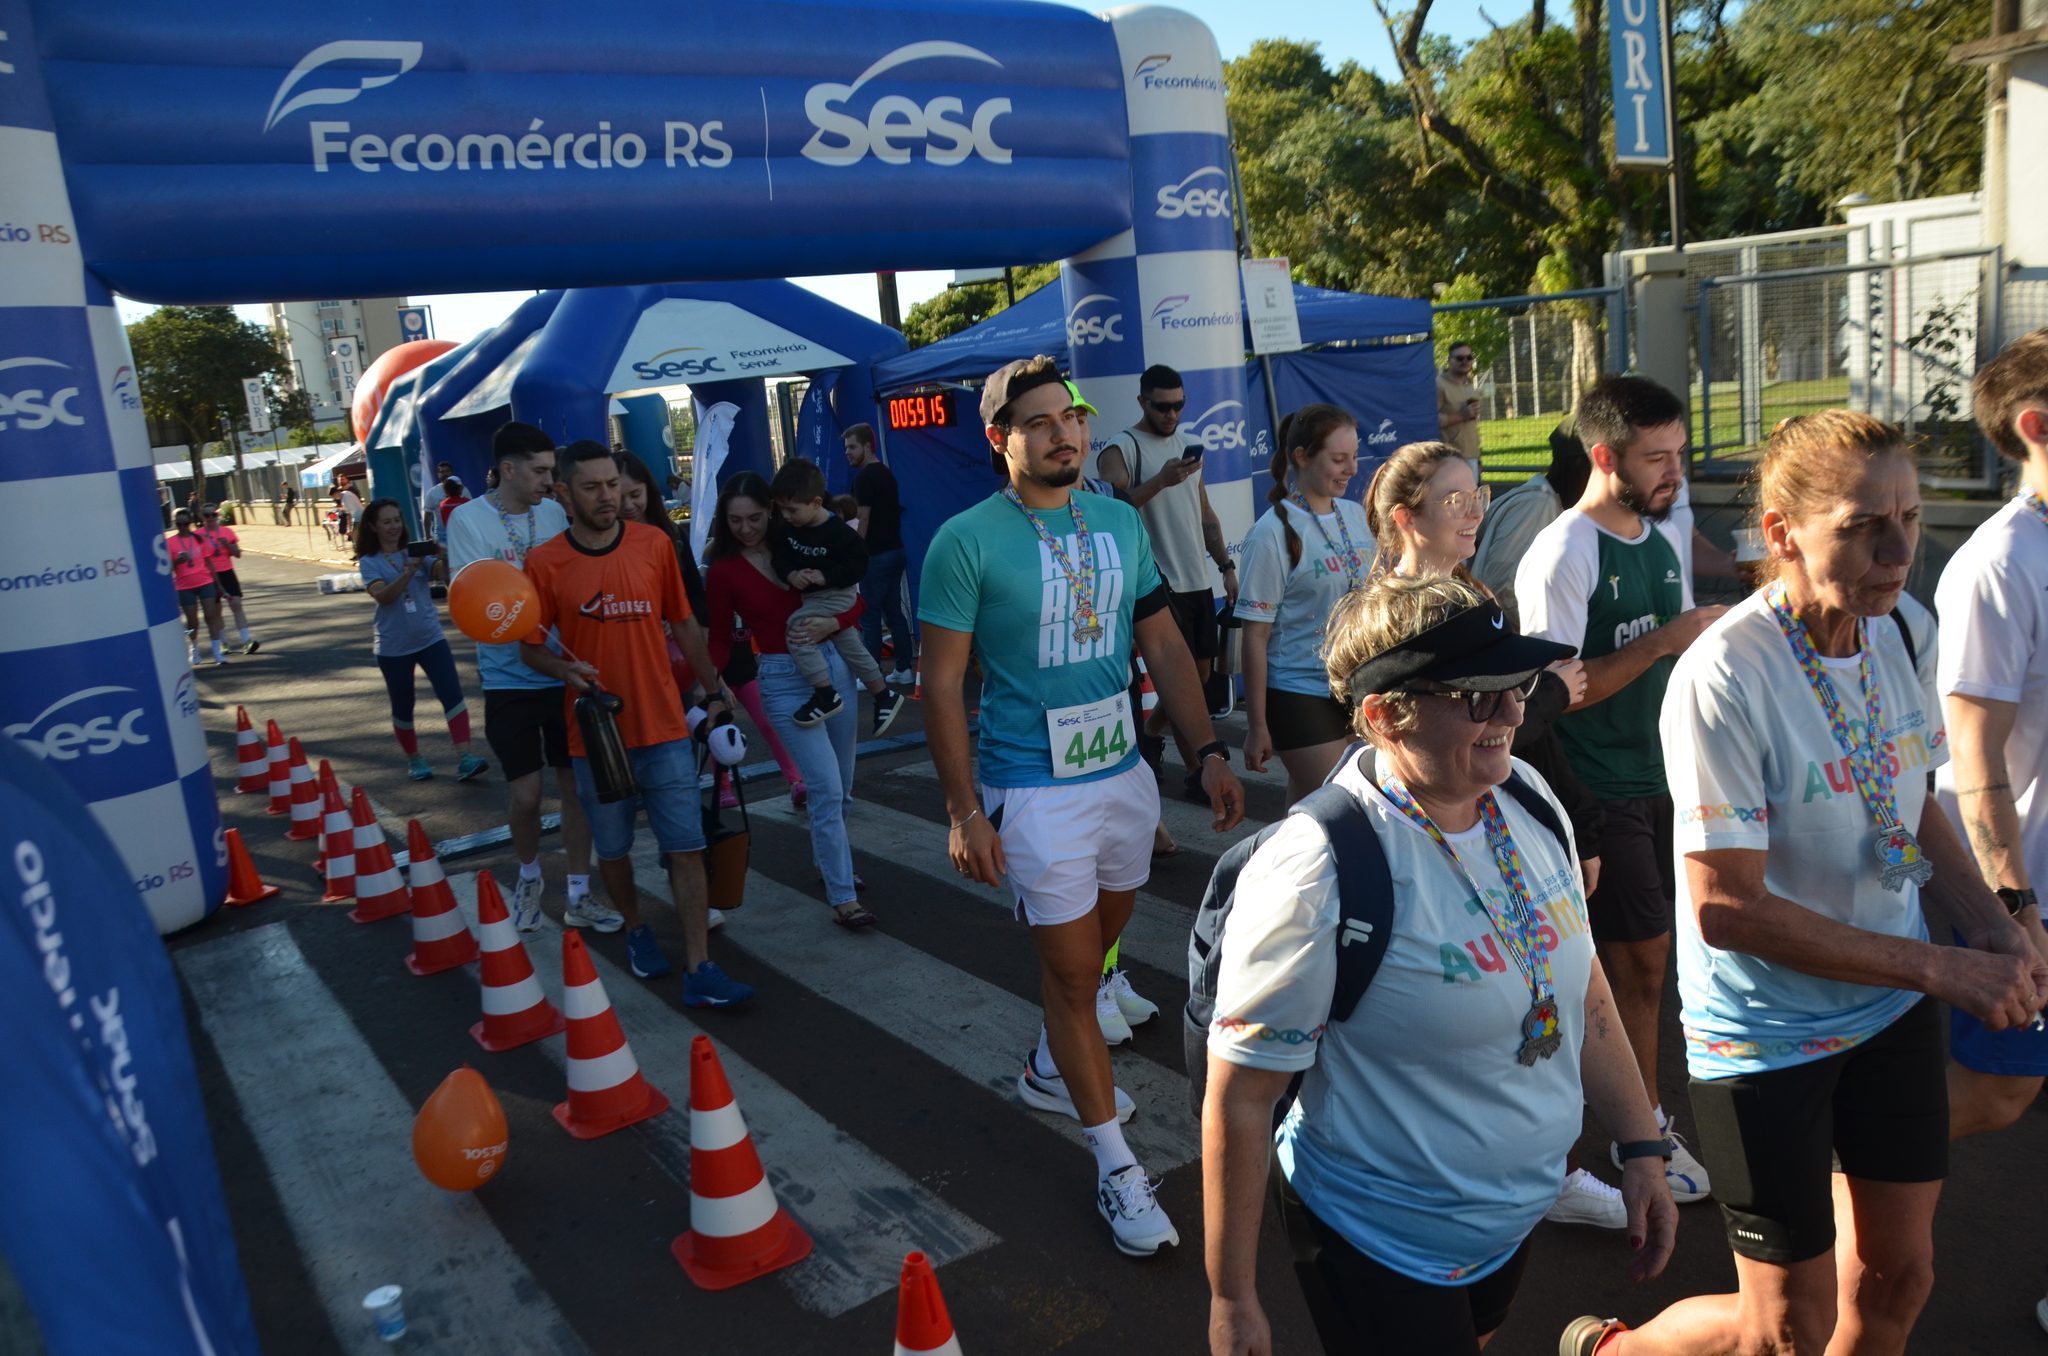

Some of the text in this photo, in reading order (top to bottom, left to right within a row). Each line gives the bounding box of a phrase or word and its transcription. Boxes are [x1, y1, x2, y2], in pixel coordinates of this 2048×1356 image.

[801, 82, 1014, 167] Sesc
[309, 118, 734, 173] Fecomércio RS
[37, 224, 72, 244] RS
[730, 343, 808, 360] Fecomércio
[249, 395, 264, 429] URI
[890, 396, 927, 429] 0059
[103, 557, 131, 578] RS
[1064, 719, 1128, 769] 444
[168, 861, 195, 883] RS
